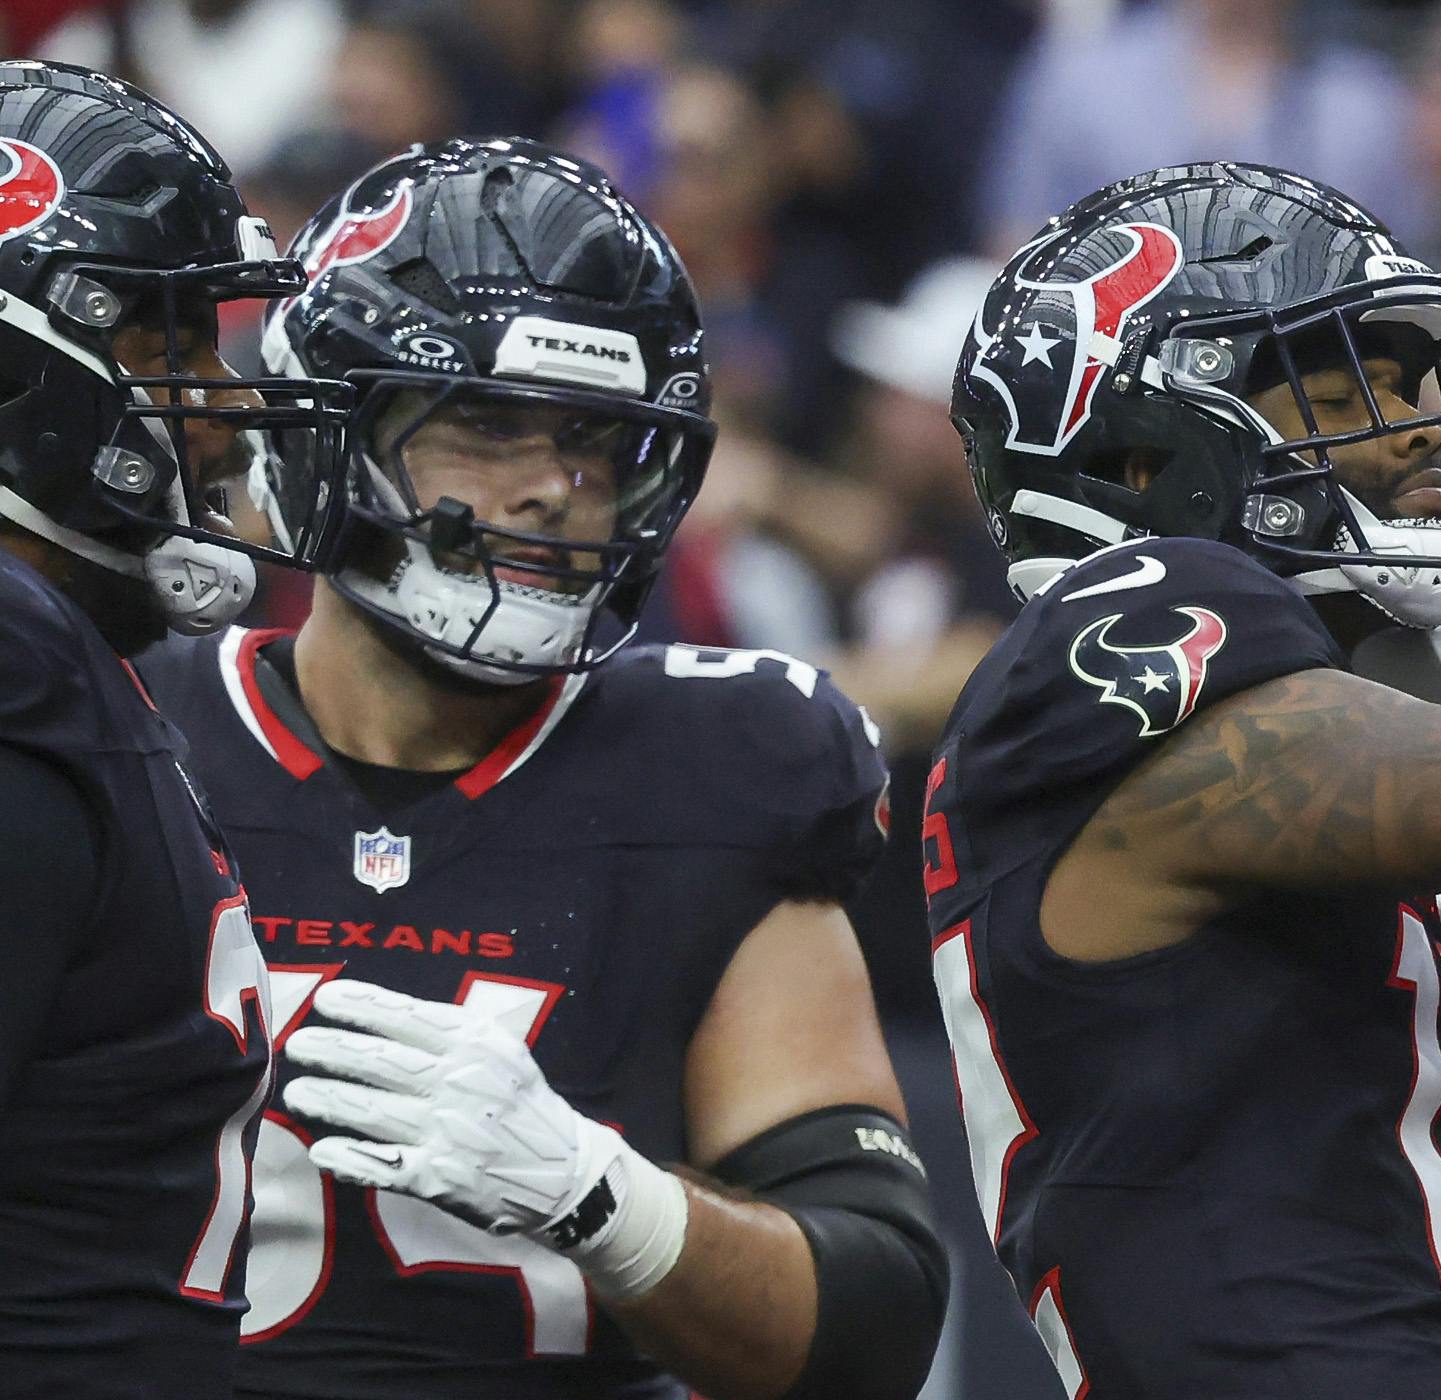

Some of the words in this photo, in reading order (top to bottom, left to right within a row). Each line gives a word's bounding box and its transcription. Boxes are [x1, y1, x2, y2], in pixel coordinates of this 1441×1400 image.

[527, 335, 631, 363] TEXANS
[363, 855, 400, 879] NFL
[253, 916, 516, 959] TEXANS
